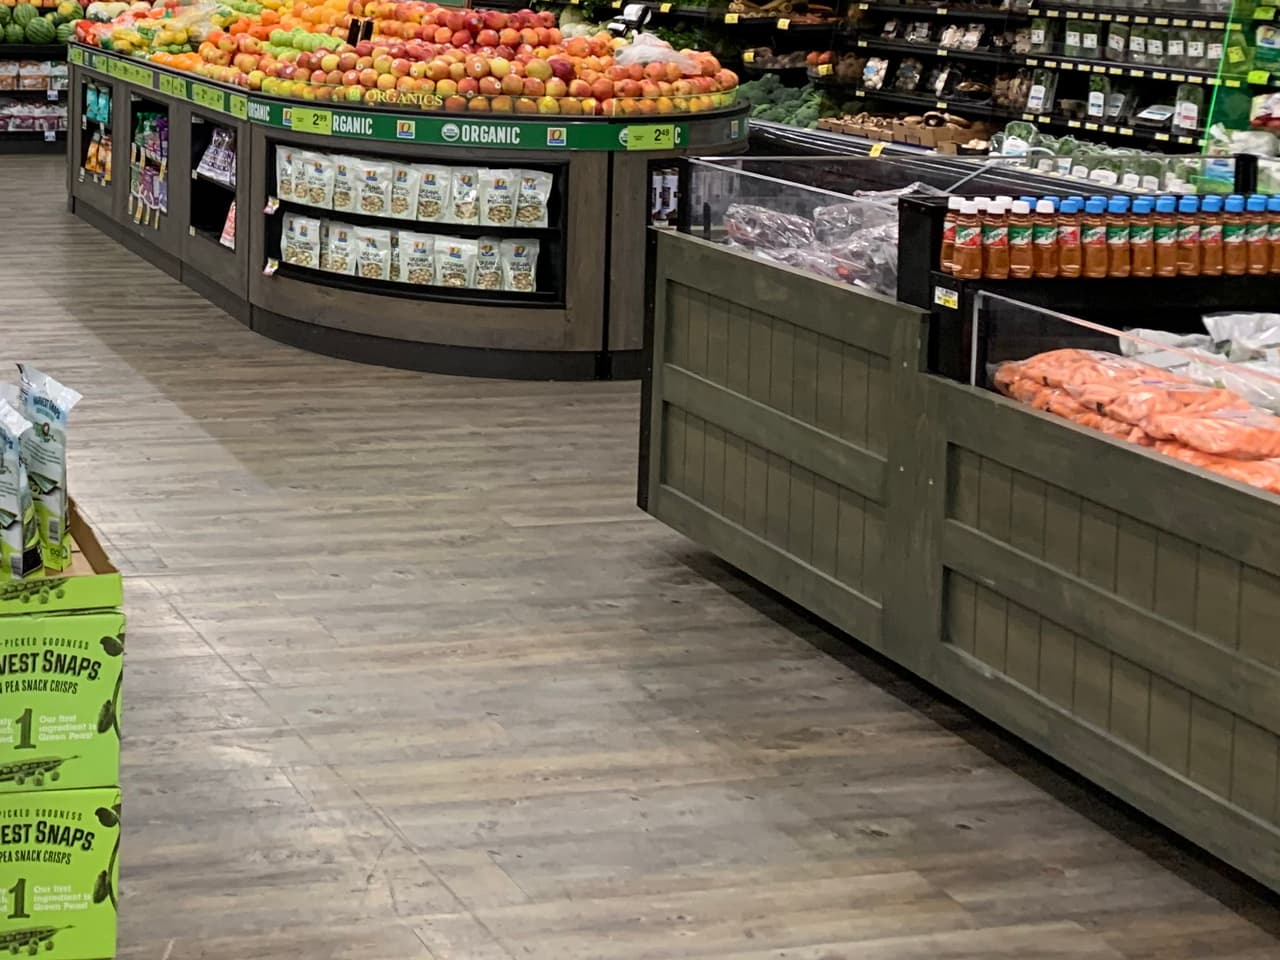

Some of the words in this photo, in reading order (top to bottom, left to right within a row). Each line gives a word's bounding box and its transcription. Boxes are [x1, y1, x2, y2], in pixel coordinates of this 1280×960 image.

[365, 88, 443, 106] ORGANICS
[247, 101, 271, 122] ORGANIC
[332, 114, 373, 135] RGANIC
[461, 124, 521, 144] ORGANIC
[43, 638, 89, 650] GOODNESS
[43, 650, 102, 681] SNAPS
[6, 681, 19, 693] PEA
[22, 680, 47, 692] SNACK
[50, 680, 78, 694] CRISPS
[14, 708, 36, 749] 1
[36, 809, 82, 821] GOODNESS
[36, 821, 95, 851] SNAPS
[0, 852, 12, 863] PEA
[15, 850, 40, 862] SNACK
[43, 850, 72, 865] CRISPS
[8, 878, 30, 919] 1
